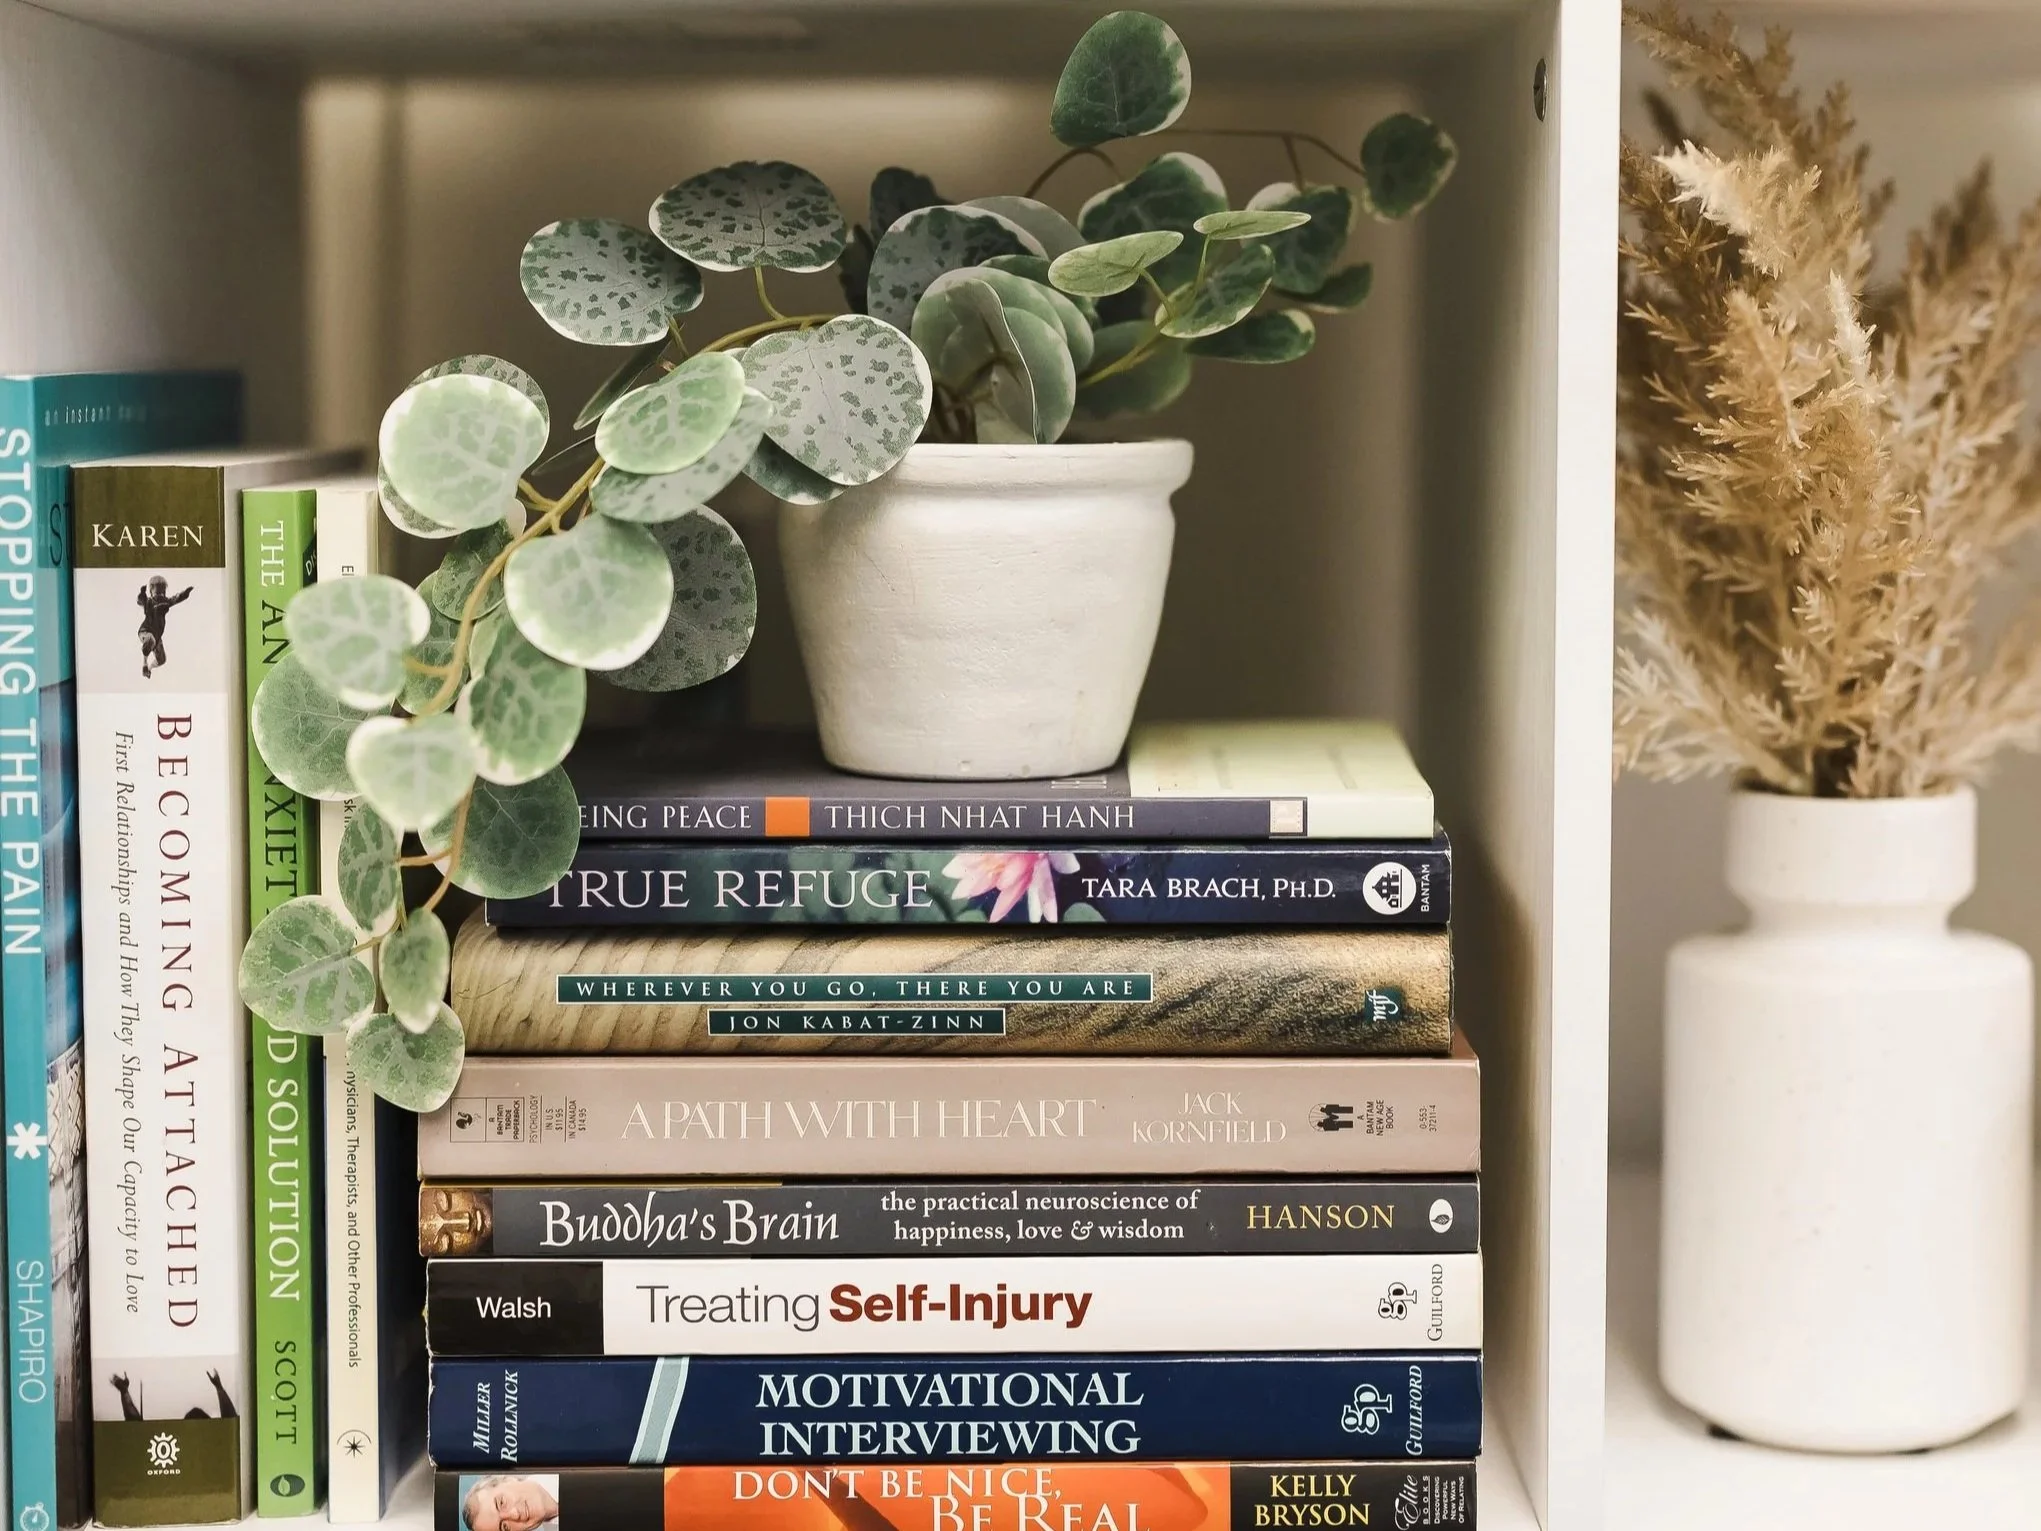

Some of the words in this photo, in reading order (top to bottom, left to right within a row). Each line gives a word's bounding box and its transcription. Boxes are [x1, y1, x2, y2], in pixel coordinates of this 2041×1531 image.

[92, 523, 204, 549] KAREN
[261, 520, 285, 588] THE
[0, 427, 36, 696] STOPPING
[0, 718, 39, 817] THE
[115, 731, 134, 773] First
[578, 804, 648, 830] EING
[662, 804, 752, 830] PEACE
[824, 804, 926, 830] THICH
[940, 804, 1027, 829] NHAT
[1041, 804, 1135, 829] HANH
[111, 780, 136, 906] Relationships
[157, 713, 194, 1012] BECOMING
[2, 841, 42, 955] PAIN
[714, 869, 933, 909] REFUGE
[1081, 877, 1156, 899] TARA
[1167, 877, 1267, 901] BRACH,
[1420, 864, 1431, 912] BANTAM
[119, 911, 138, 948] and
[120, 954, 139, 997] How
[576, 981, 735, 997] WHEREVER
[751, 981, 807, 997] YOU
[827, 980, 877, 999] GO,
[896, 980, 989, 996] THERE
[1008, 980, 1064, 996] YOU
[1082, 980, 1135, 996] ARE
[114, 1002, 141, 1047] They
[730, 1014, 783, 1031] JON
[803, 1014, 985, 1031] KABAT-ZINN
[115, 1054, 141, 1110] Shape
[496, 1104, 504, 1136] BANTAM
[529, 1094, 538, 1144] PSYCHOLOGY
[568, 1099, 577, 1130] CANADA
[620, 1101, 656, 1140] A
[662, 1101, 778, 1140] PATH
[784, 1101, 920, 1139] WITH
[937, 1100, 1097, 1138] HEART
[1177, 1092, 1243, 1116] JACK
[1366, 1101, 1374, 1135] BANTAM
[1376, 1099, 1384, 1115] AGE
[1386, 1106, 1394, 1130] BOOK
[123, 1116, 142, 1152] Our
[545, 1121, 553, 1131] IN
[568, 1131, 576, 1140] IN
[1131, 1120, 1288, 1144] KORNFIELD
[1376, 1117, 1384, 1136] NEW
[163, 1043, 199, 1328] ATTACHED
[268, 1079, 300, 1302] SOLUTION
[345, 1136, 360, 1207] Therapists,
[117, 1159, 143, 1242] Capacity
[540, 1191, 716, 1249] Buddha's
[722, 1200, 840, 1246] Brain
[880, 1191, 920, 1212] the
[924, 1190, 1019, 1217] practical
[1025, 1191, 1169, 1211] neuroscience
[1175, 1189, 1201, 1210] of
[1246, 1204, 1396, 1230] HANSON
[347, 1210, 359, 1234] and
[893, 1220, 1012, 1247] happiness,
[1017, 1219, 1063, 1240] love
[1070, 1220, 1094, 1241] &
[1099, 1219, 1185, 1240] wisdom
[125, 1244, 139, 1267] to
[347, 1237, 361, 1277] Other
[126, 1274, 145, 1313] Love
[476, 1296, 552, 1319] Walsh
[636, 1284, 820, 1332] Treating
[829, 1283, 1093, 1330] Self-Injury
[1427, 1263, 1443, 1342] GUILFORD
[16, 1260, 47, 1404] SHAPIRO
[348, 1282, 361, 1369] Professionals
[275, 1341, 298, 1445] SCOTT
[755, 1372, 1145, 1409] MOTIVATIONAL
[472, 1382, 491, 1454] MILLER
[501, 1370, 519, 1463] ROLLNICK
[1405, 1365, 1424, 1456] GUILFORD
[759, 1419, 1142, 1457] INTERVIEWING
[732, 1469, 866, 1501] DON'T
[880, 1469, 924, 1499] BE
[945, 1467, 1062, 1500] NICE,
[1270, 1474, 1357, 1498] KELLY
[1394, 1474, 1421, 1531] Elite
[1254, 1503, 1371, 1527] BRYSON
